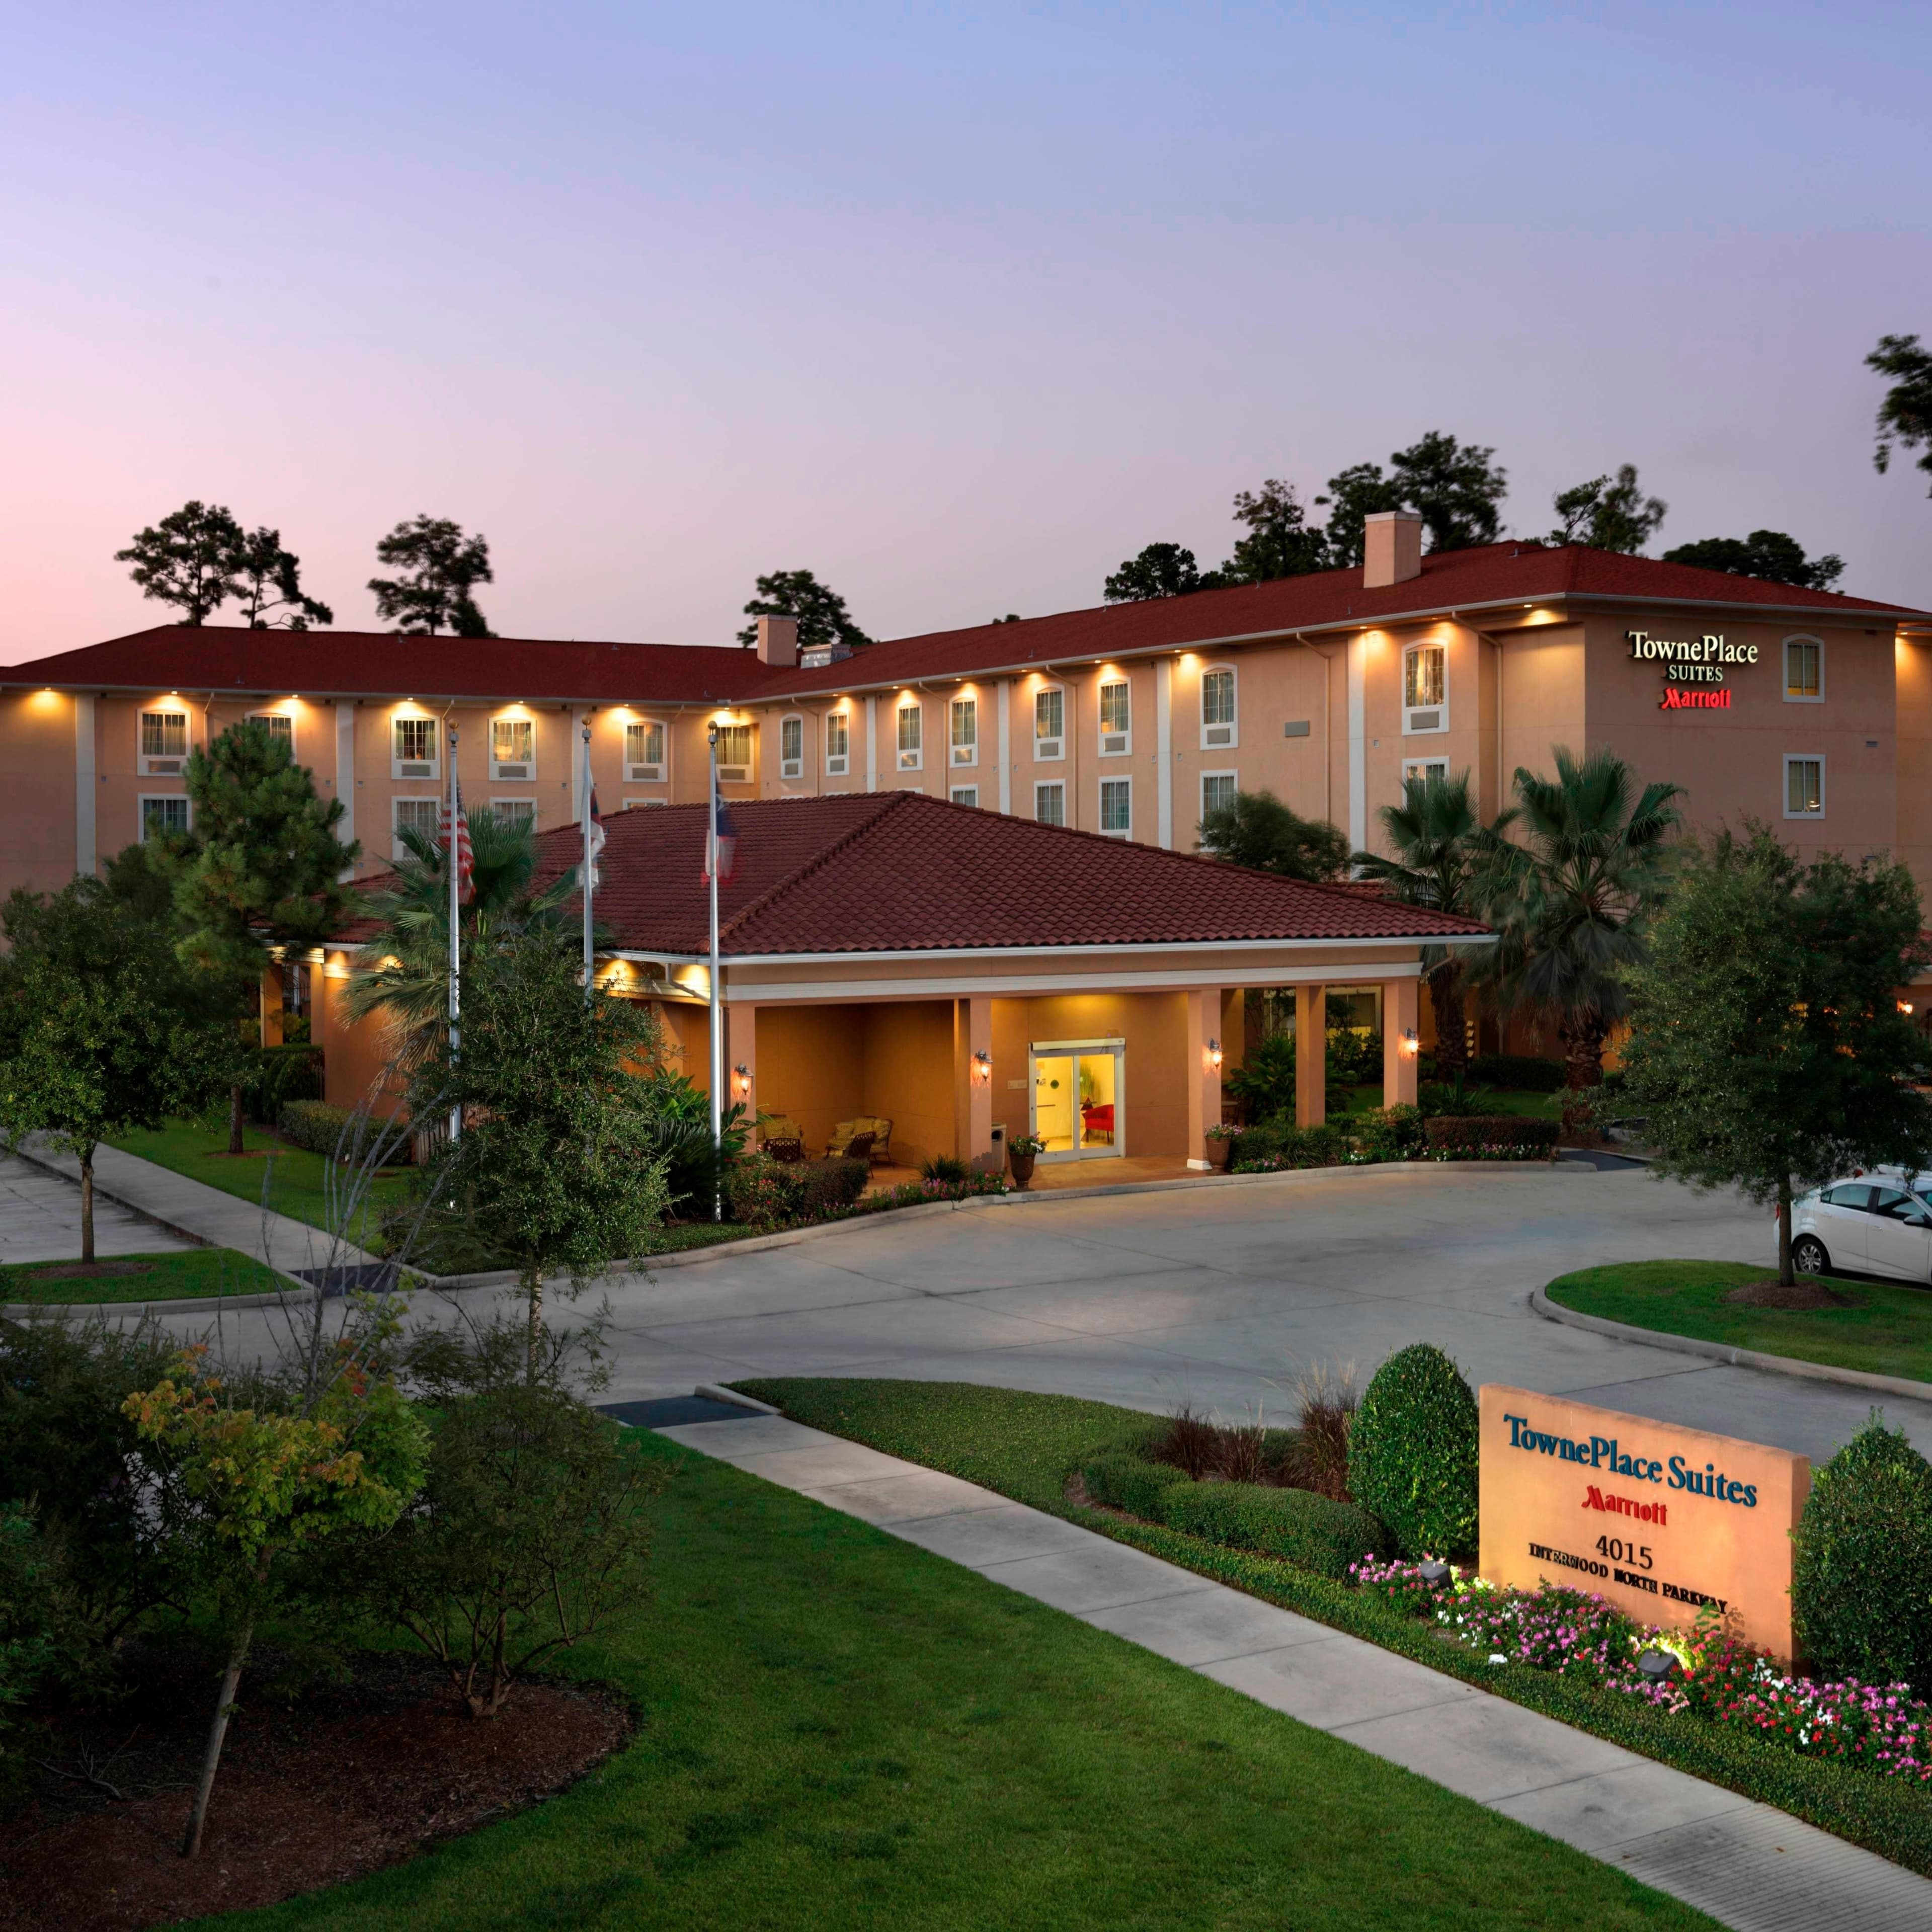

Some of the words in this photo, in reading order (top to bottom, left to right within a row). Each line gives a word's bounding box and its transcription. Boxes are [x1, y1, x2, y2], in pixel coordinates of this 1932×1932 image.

[1628, 630, 1758, 663] TownePlace
[1669, 665, 1723, 681] SUITES
[1661, 688, 1731, 710] Marriott
[1503, 1414, 1662, 1483] TownePlace
[1668, 1456, 1757, 1507] Suites
[1581, 1485, 1667, 1526] Marriott
[1528, 1542, 1609, 1578] INTERWOOD
[1613, 1568, 1658, 1594] NORTH
[1595, 1535, 1653, 1570] 4015
